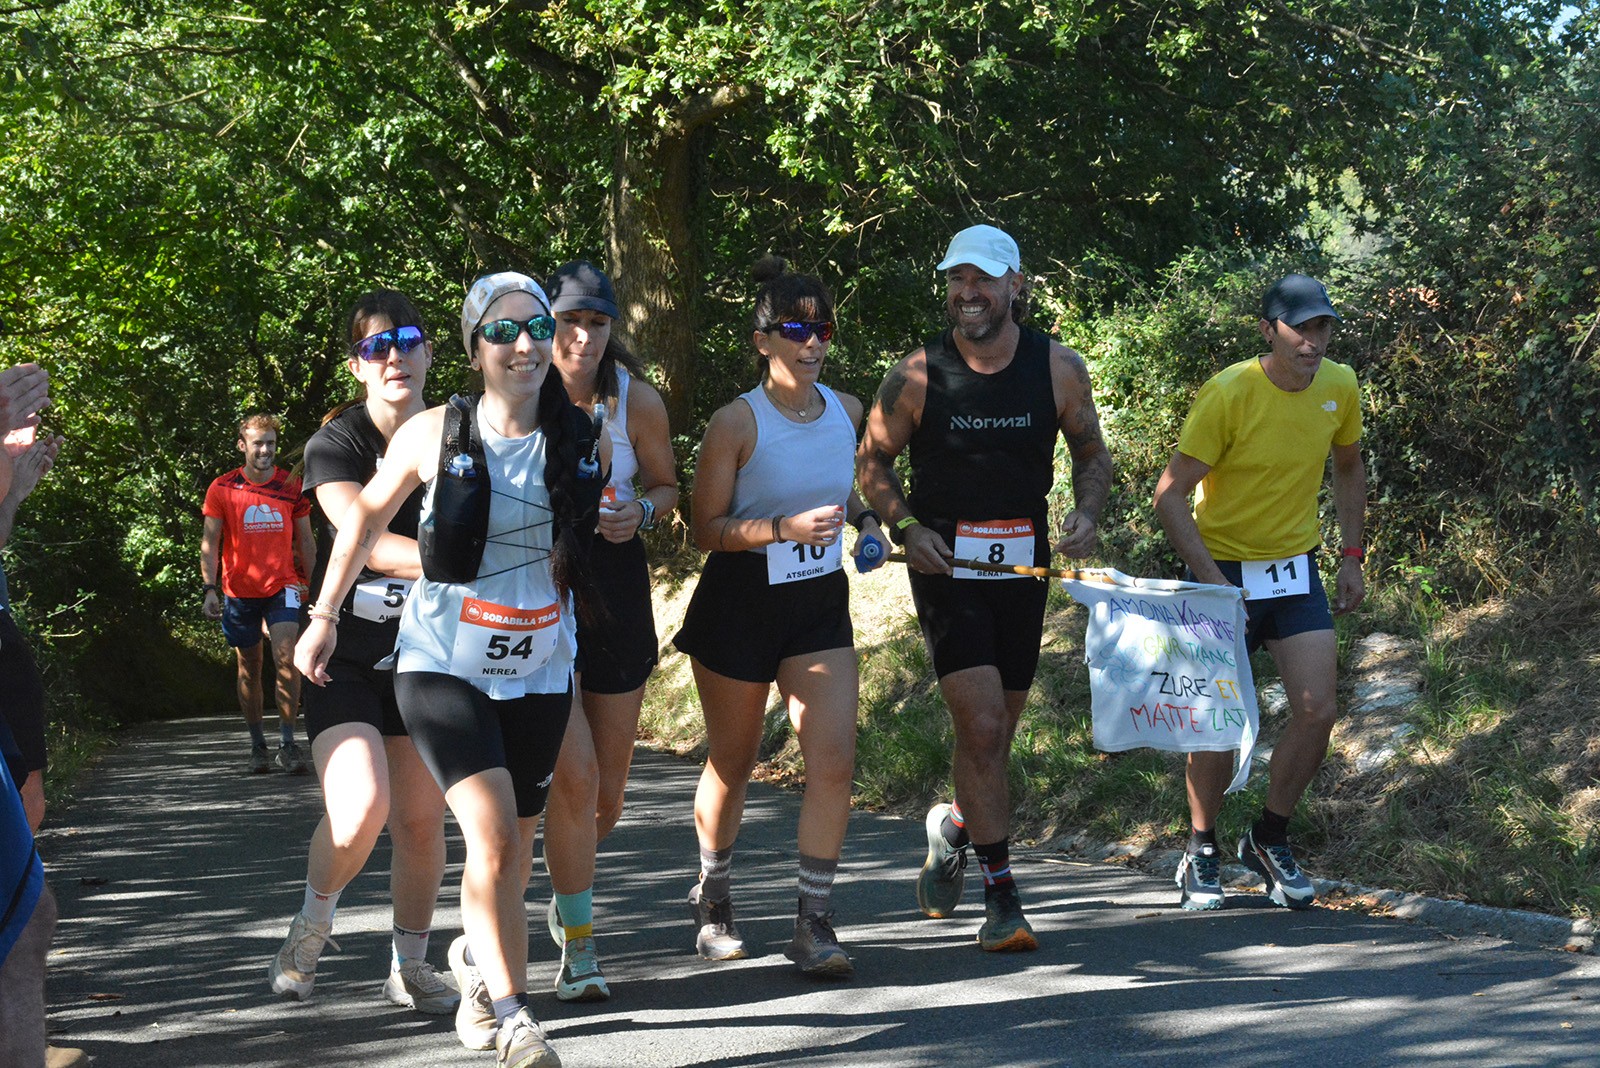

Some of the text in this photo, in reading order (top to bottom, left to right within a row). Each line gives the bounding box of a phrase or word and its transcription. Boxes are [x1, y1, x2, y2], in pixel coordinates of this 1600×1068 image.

[973, 525, 1031, 534] SORABILLA TRAIL
[792, 543, 826, 564] 10
[988, 543, 1005, 564] 8
[1265, 561, 1297, 583] 11
[383, 583, 411, 608] 5
[482, 611, 558, 626] SORABILLA TRAIL
[1109, 598, 1182, 632] AMONA
[486, 635, 533, 660] 54
[1151, 671, 1212, 698] ZURE
